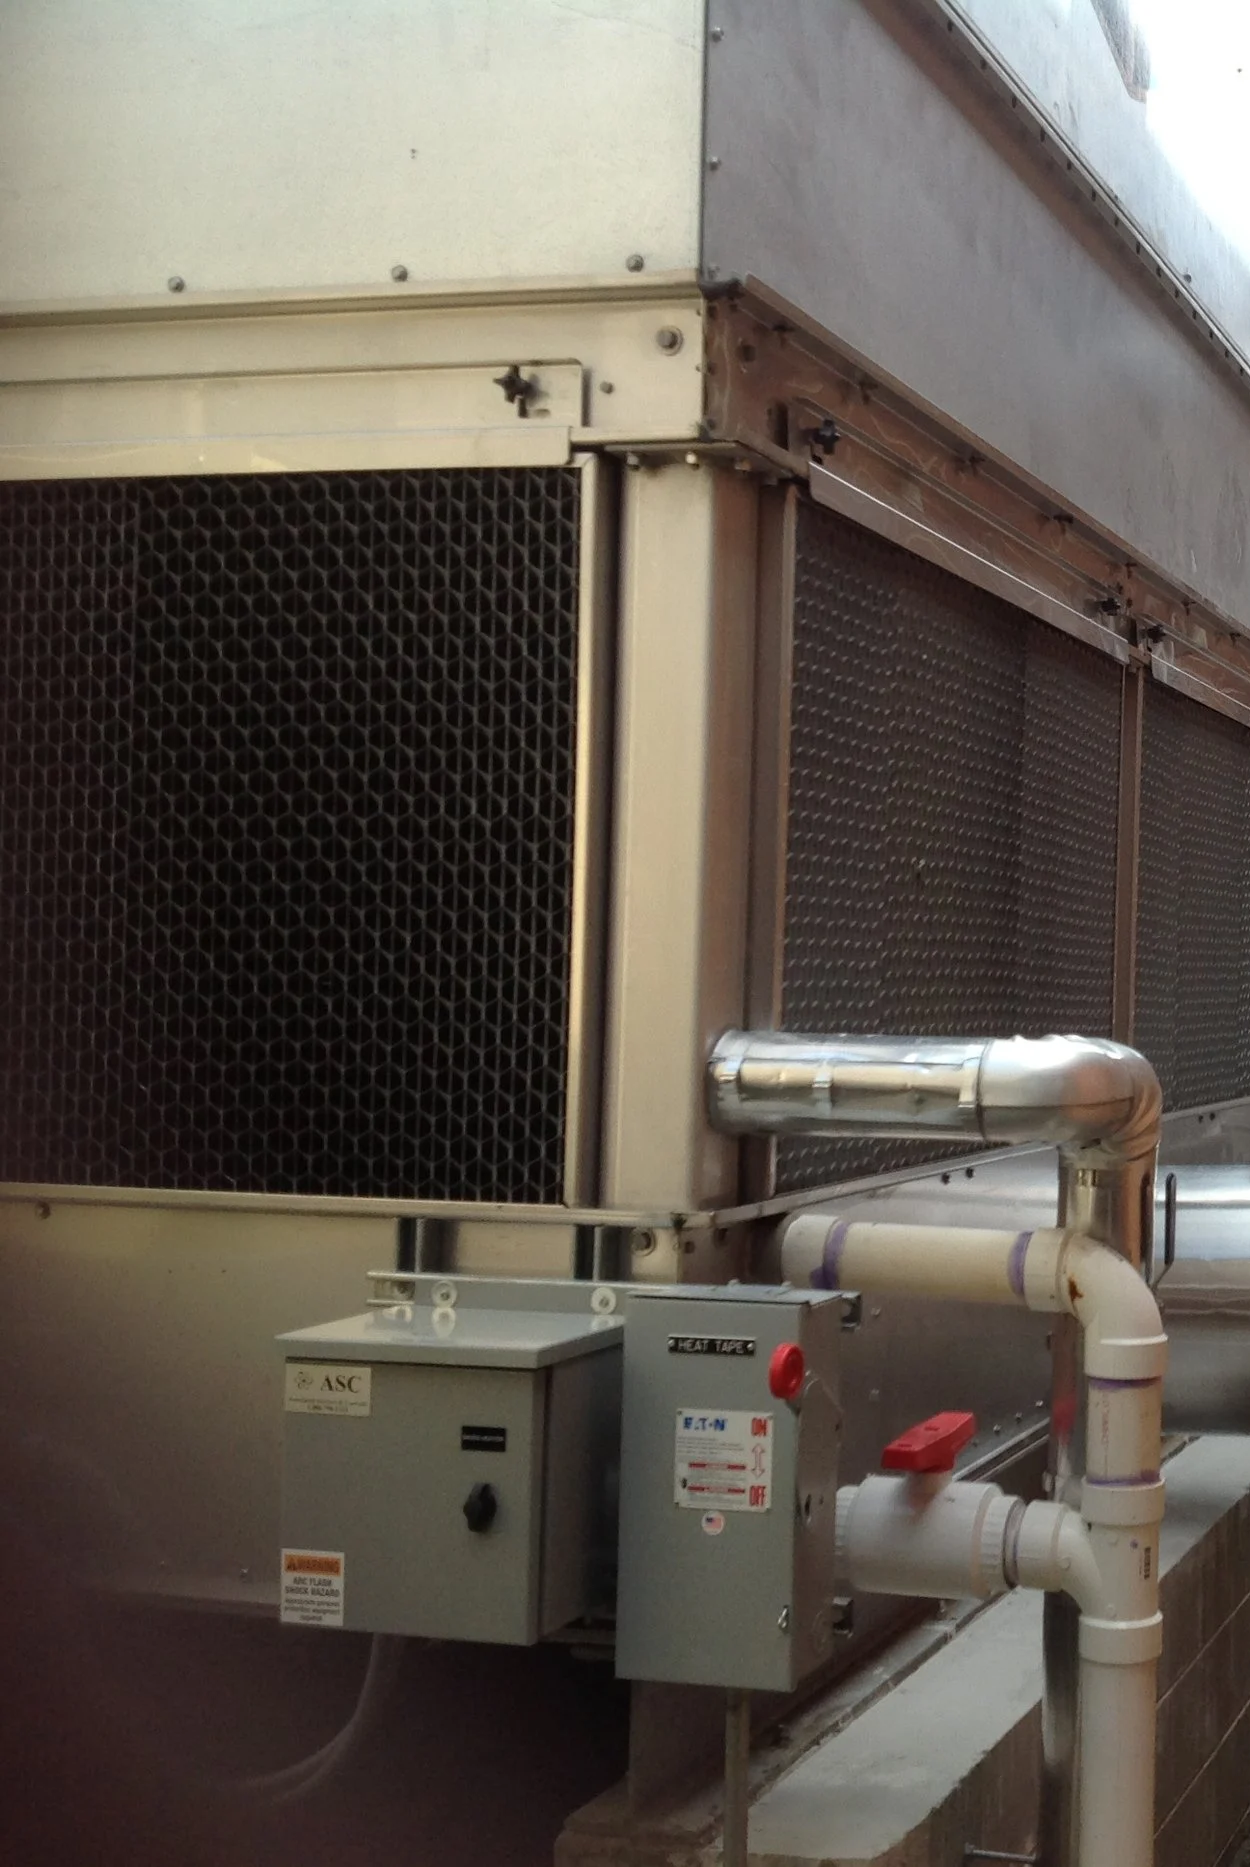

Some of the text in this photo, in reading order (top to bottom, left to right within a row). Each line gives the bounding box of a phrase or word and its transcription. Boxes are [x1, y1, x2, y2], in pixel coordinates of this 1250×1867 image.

[678, 1339, 744, 1354] HEAT TAPE
[320, 1374, 361, 1394] ASC
[751, 1416, 767, 1437] ON
[749, 1485, 766, 1507] OFF
